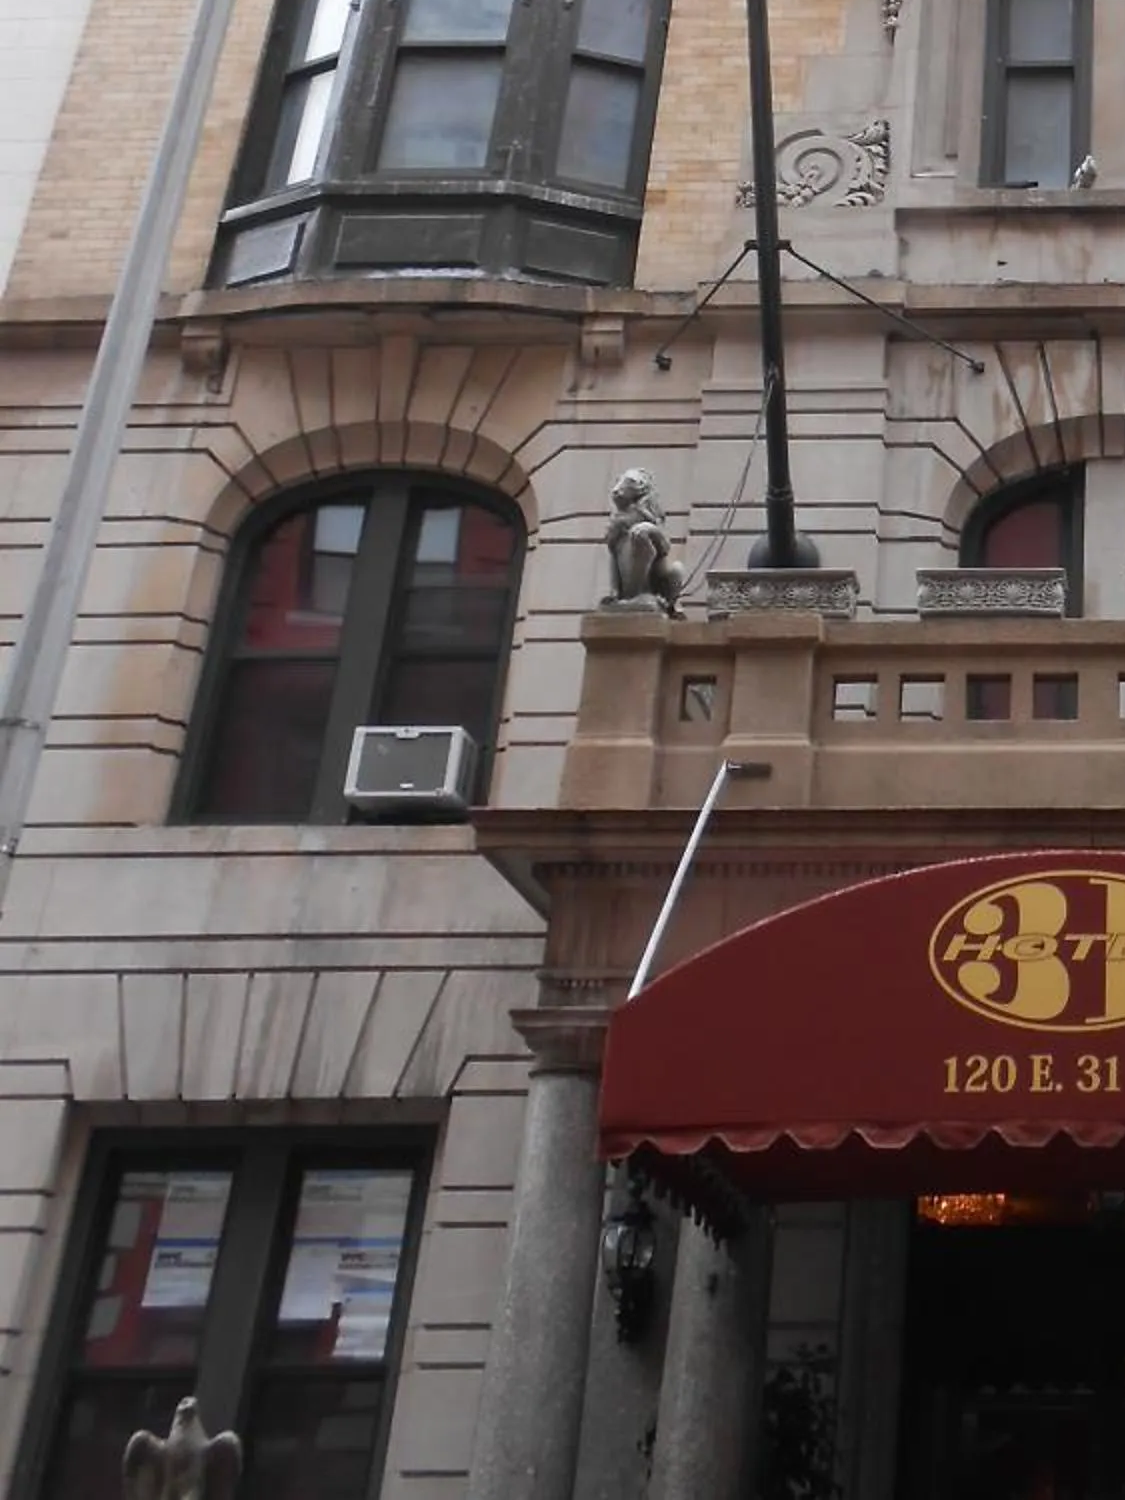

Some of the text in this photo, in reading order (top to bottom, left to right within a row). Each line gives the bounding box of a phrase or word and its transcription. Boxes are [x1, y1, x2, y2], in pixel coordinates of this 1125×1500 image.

[943, 1054, 1018, 1093] 120
[1029, 1054, 1064, 1093] E.
[1076, 1054, 1122, 1093] 31
